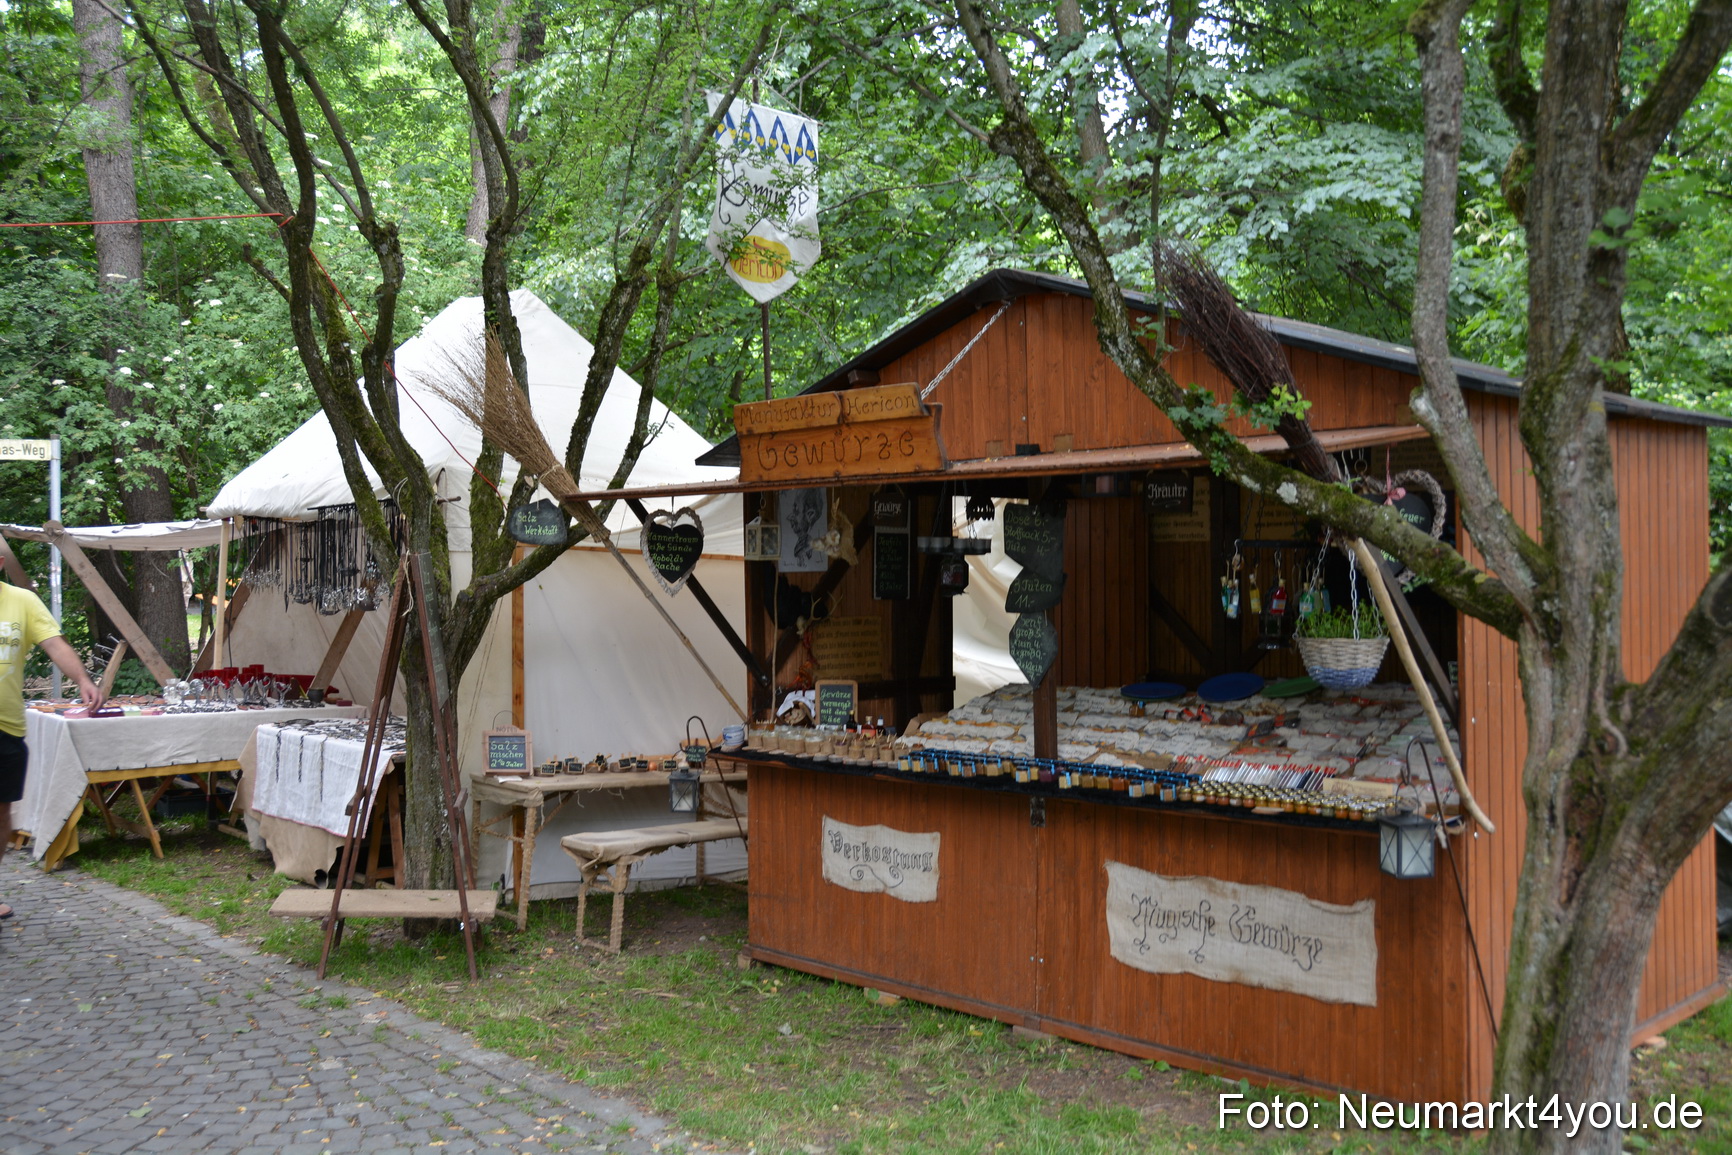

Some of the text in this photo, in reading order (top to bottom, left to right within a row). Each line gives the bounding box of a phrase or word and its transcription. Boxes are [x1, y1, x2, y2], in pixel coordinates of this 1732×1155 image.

[740, 394, 916, 426] Manufaktur Hericon
[0, 443, 46, 459] as-Weg
[757, 429, 915, 471] Gewürze
[1147, 482, 1188, 499] Kräuter
[517, 511, 537, 522] Salz
[1006, 510, 1030, 526] Dose
[490, 740, 518, 750] Salz
[1130, 893, 1323, 971] Magische Gewürze
